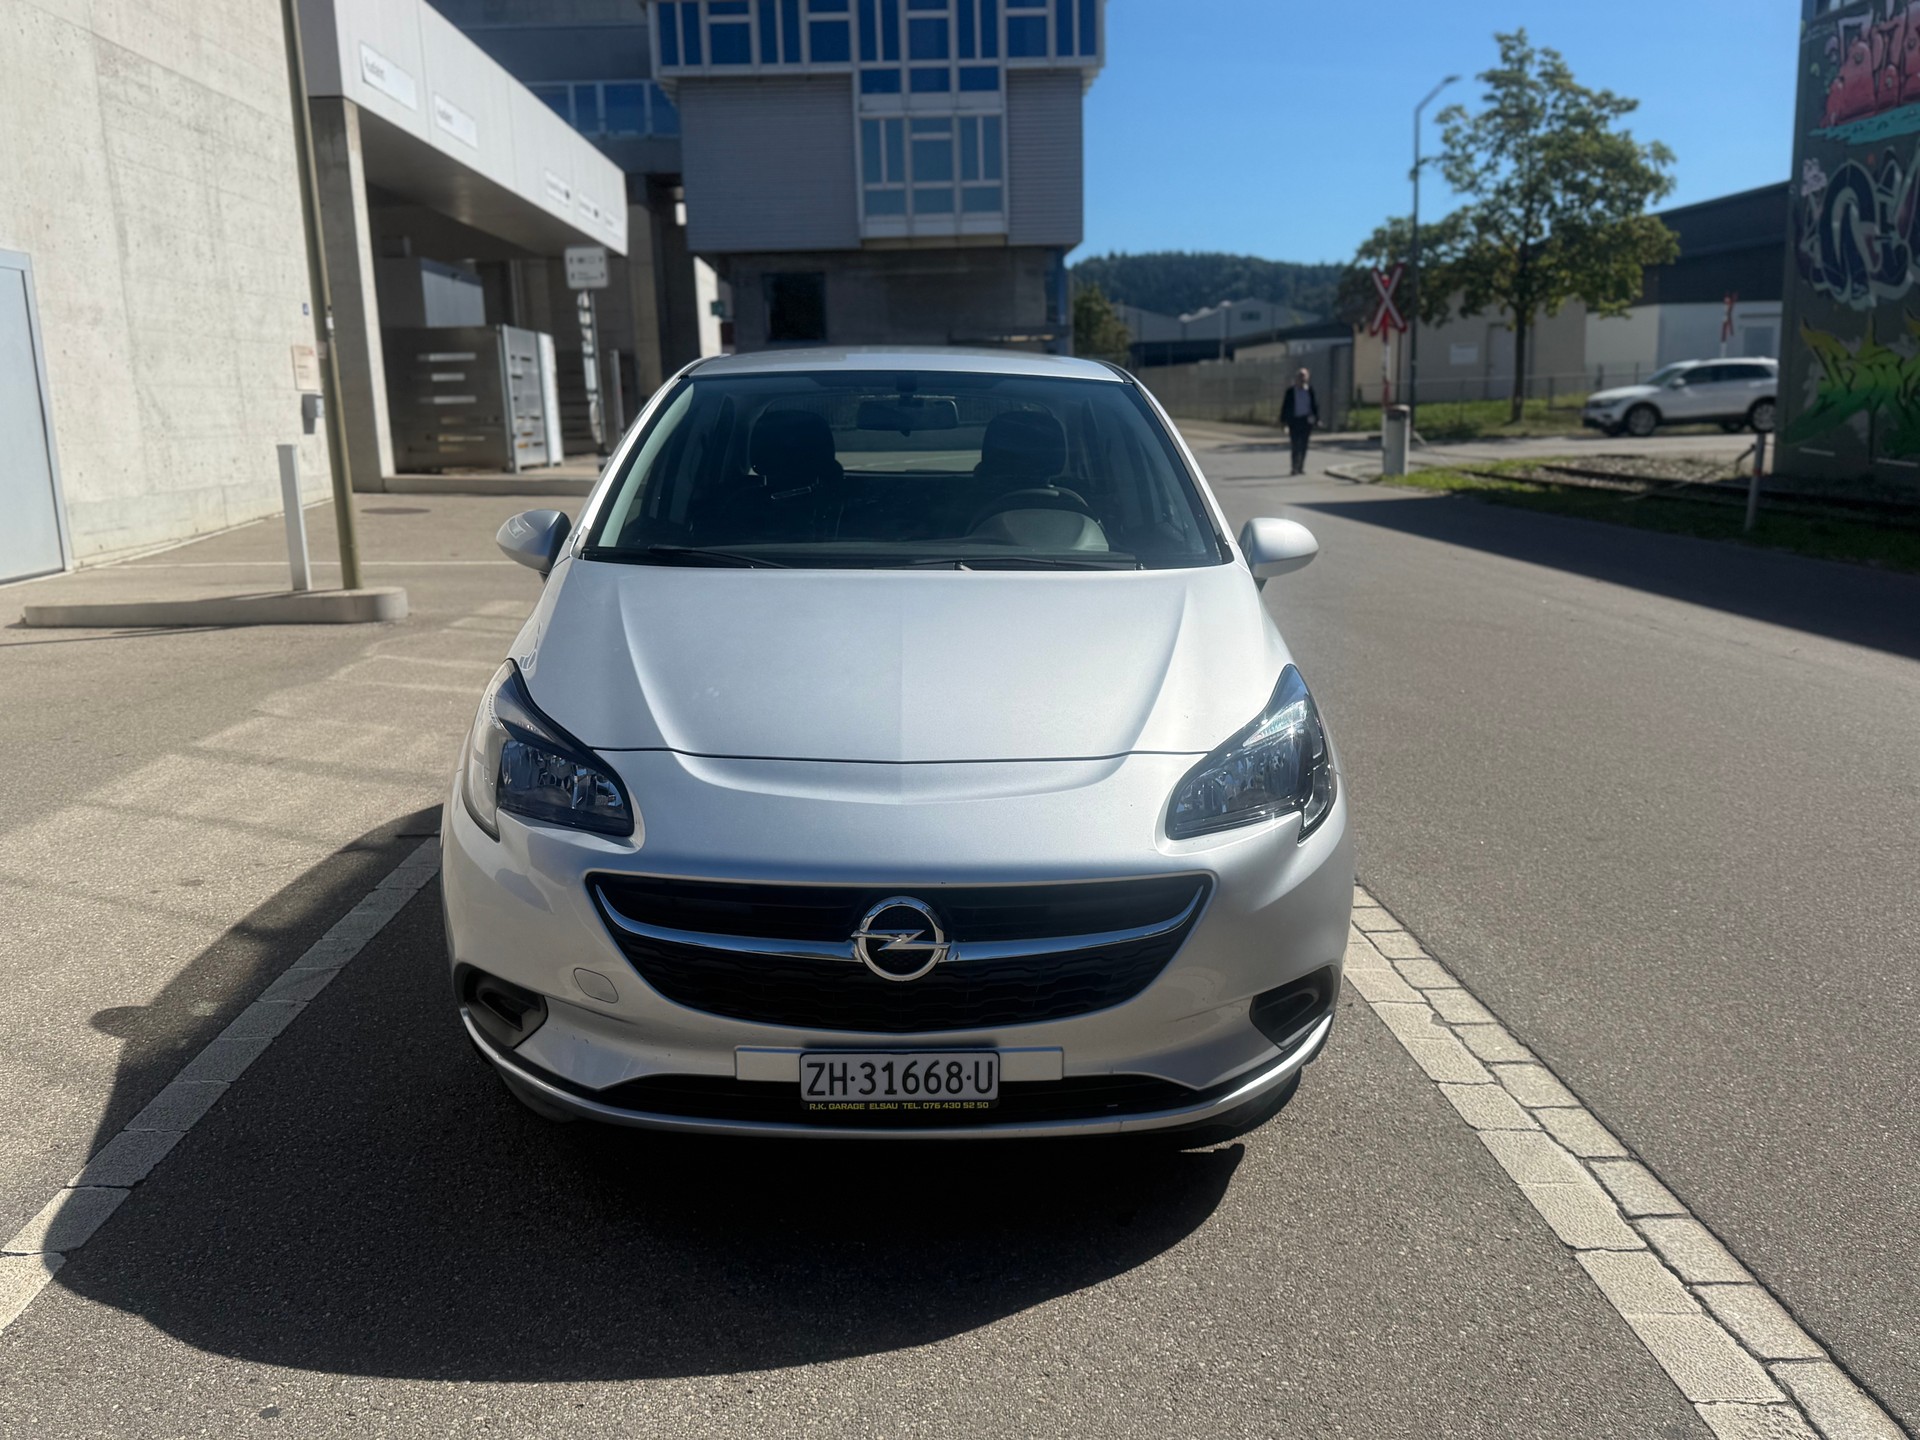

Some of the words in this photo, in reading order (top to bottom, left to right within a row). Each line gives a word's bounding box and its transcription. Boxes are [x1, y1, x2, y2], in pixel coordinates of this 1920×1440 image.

[902, 1102, 921, 1110] TEL.
[923, 1102, 941, 1110] 076
[942, 1102, 961, 1110] 430
[963, 1101, 975, 1110] 52
[977, 1101, 989, 1109] 50
